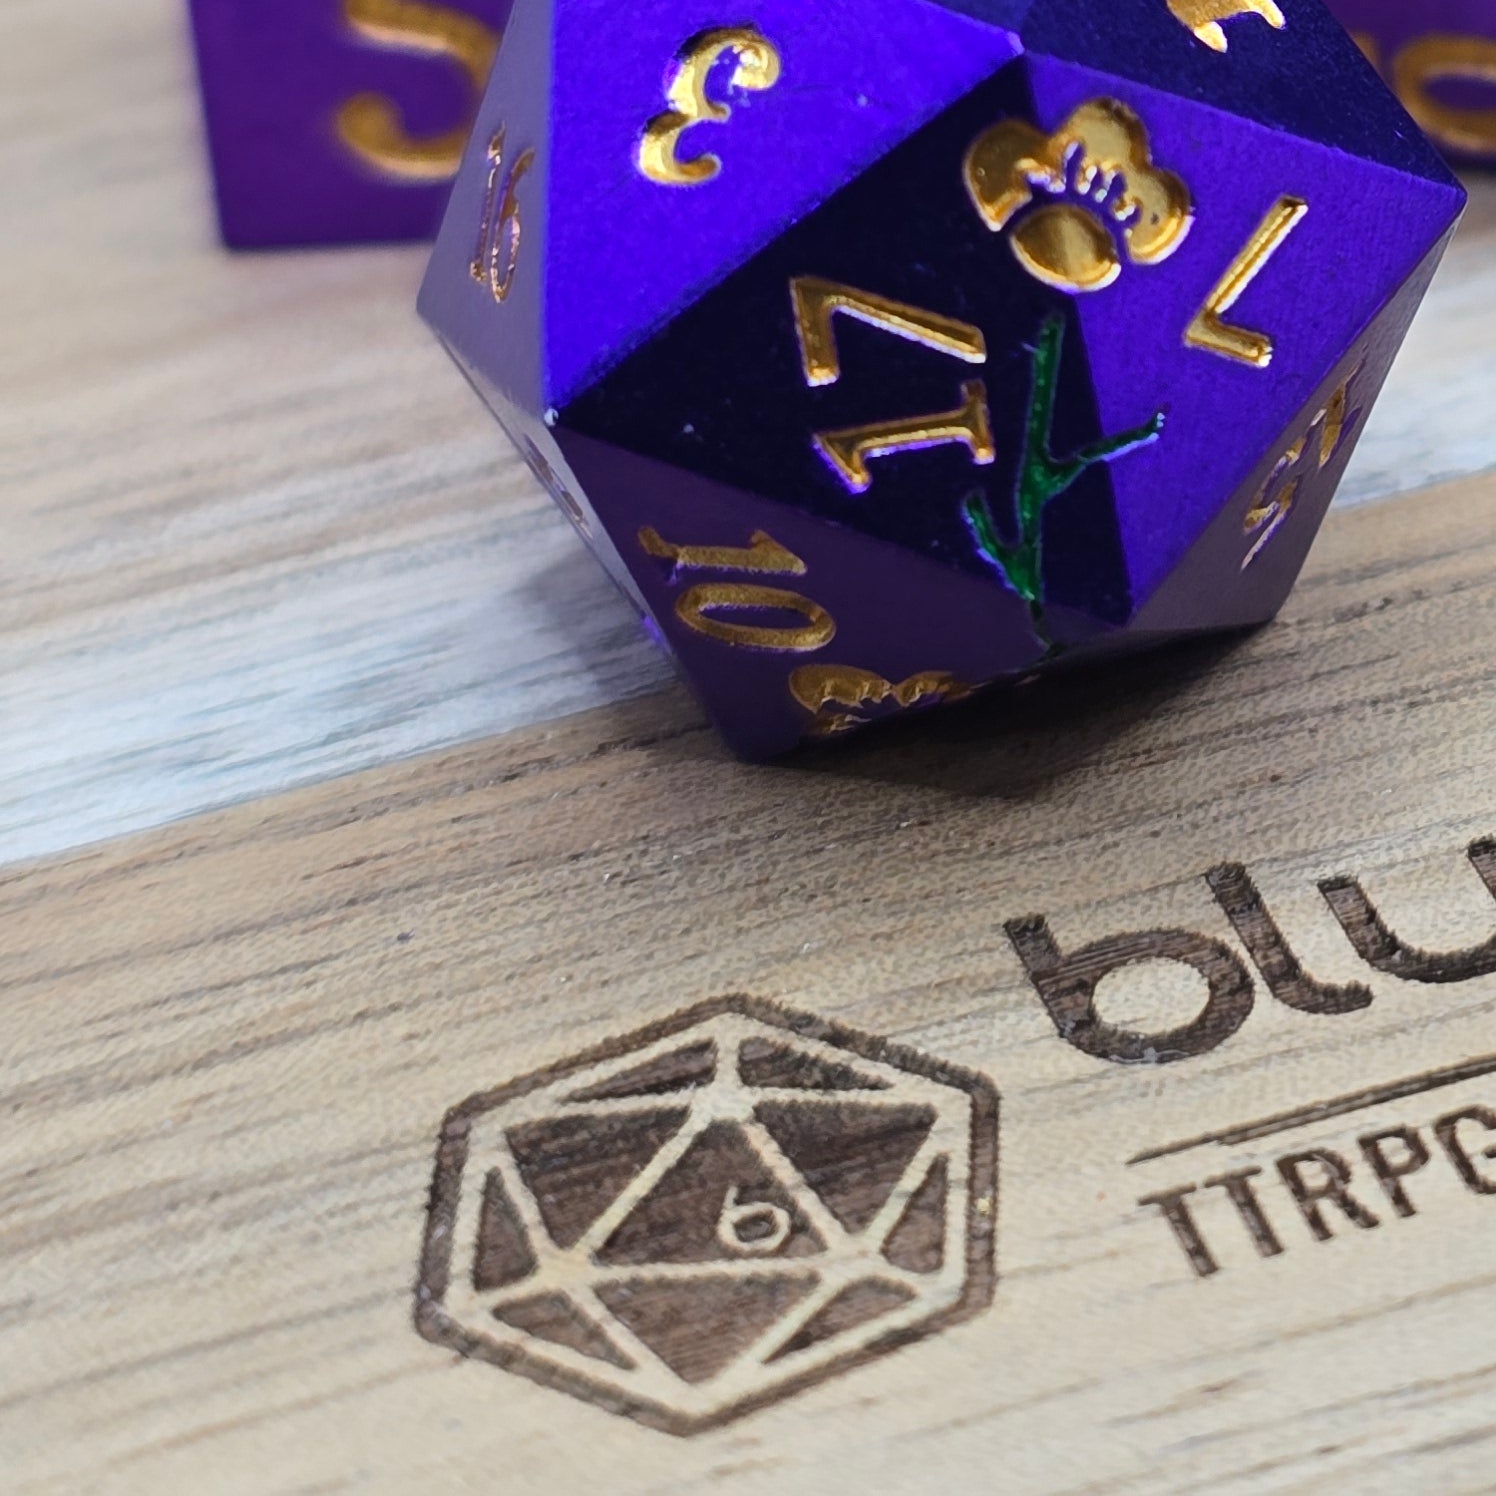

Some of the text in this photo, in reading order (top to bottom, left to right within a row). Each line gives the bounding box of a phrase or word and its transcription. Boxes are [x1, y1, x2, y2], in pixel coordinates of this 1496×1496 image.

[637, 23, 782, 185] 3
[1183, 196, 1308, 368] 7
[790, 276, 995, 494] 17
[637, 526, 838, 652] 10
